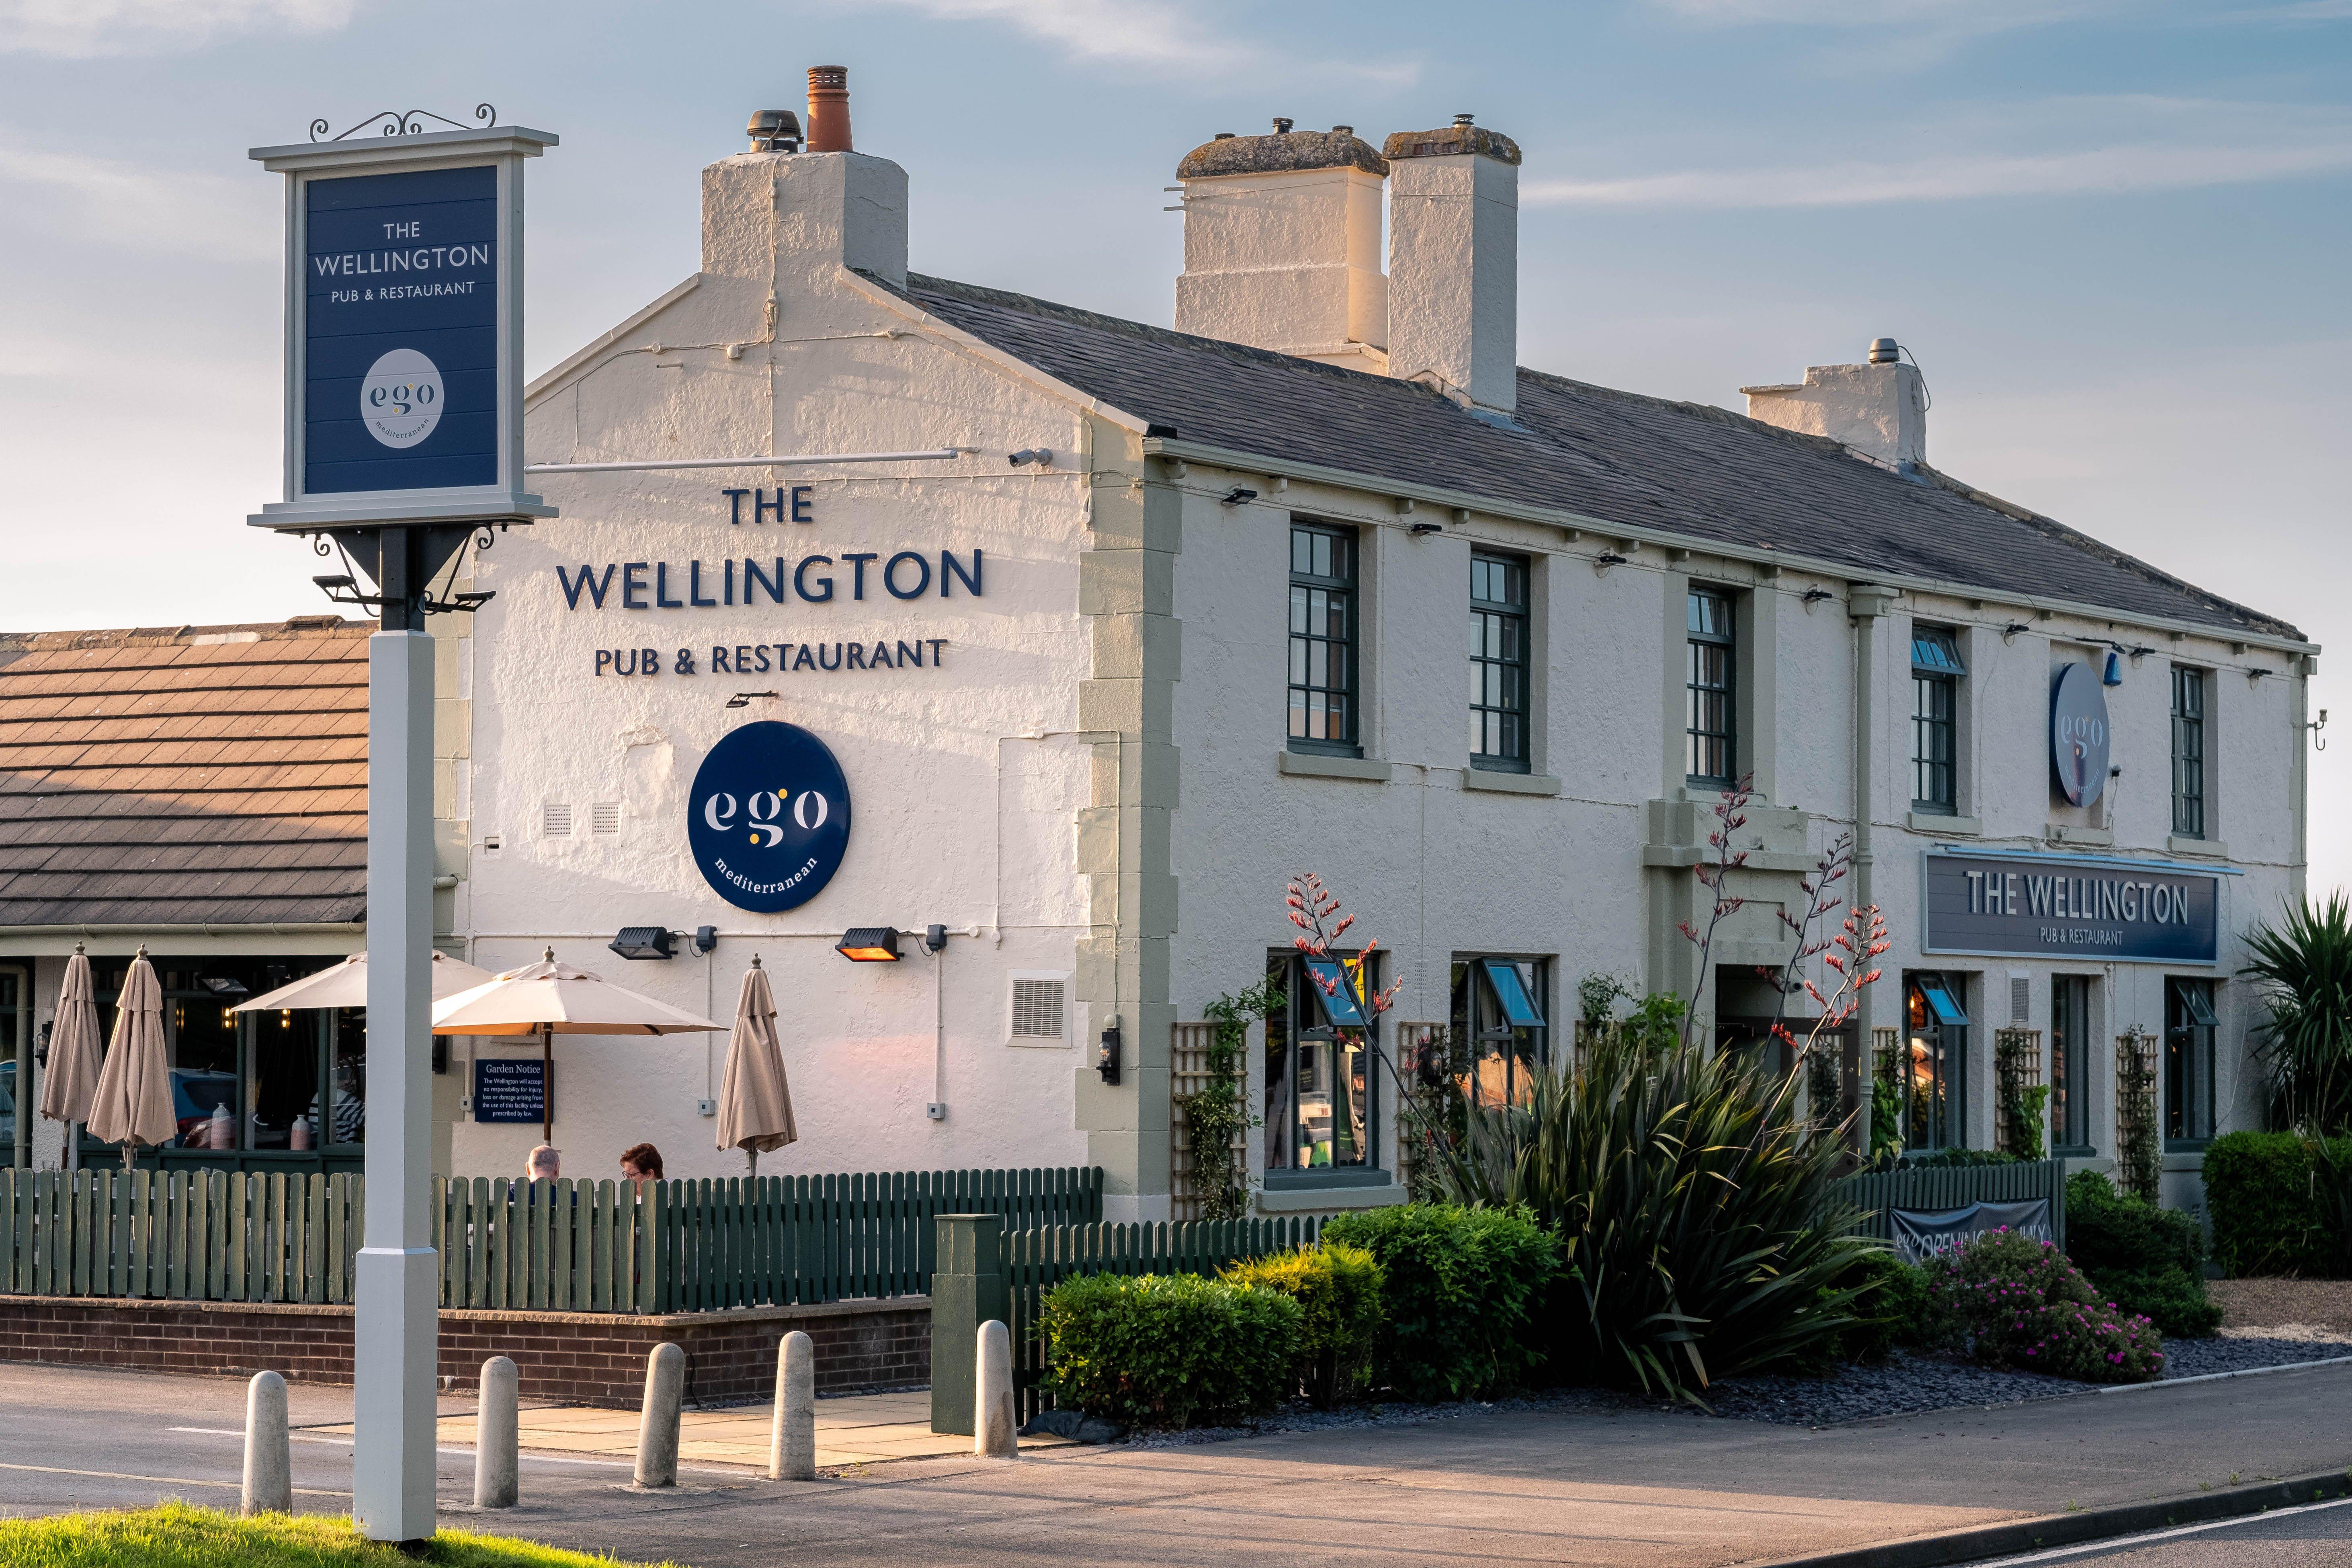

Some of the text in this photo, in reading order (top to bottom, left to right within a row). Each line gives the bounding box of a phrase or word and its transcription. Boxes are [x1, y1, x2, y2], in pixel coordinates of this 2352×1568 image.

[383, 222, 420, 239] THE
[316, 245, 488, 276] WELLINGTON
[332, 282, 475, 302] PUB & RESTAURANT
[370, 383, 434, 415] ego
[375, 418, 429, 439] mediterranean
[722, 486, 812, 525] THE
[556, 549, 981, 610] WELLINGTON
[596, 639, 948, 676] PUB & RESTAURANT
[2061, 715, 2103, 758] ego
[2065, 765, 2100, 793] mediterranean
[705, 789, 828, 848] ego
[715, 857, 817, 893] mediterranean
[1966, 871, 2188, 924] THE WELLINGTON
[2039, 927, 2123, 945] PUB & RESTAURANT
[486, 1064, 541, 1073] Garden Notice
